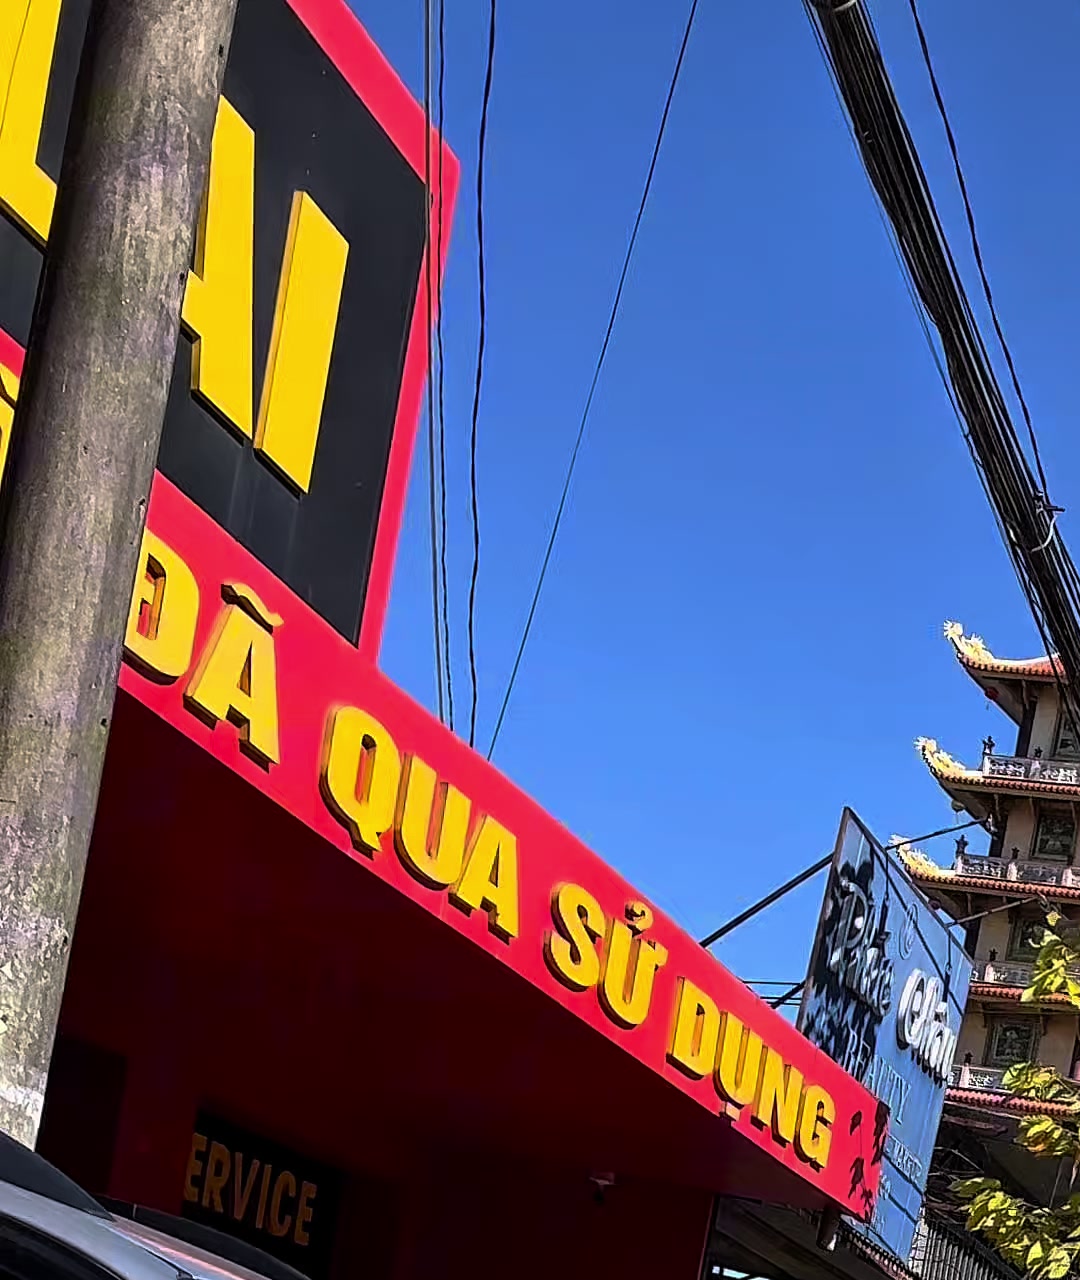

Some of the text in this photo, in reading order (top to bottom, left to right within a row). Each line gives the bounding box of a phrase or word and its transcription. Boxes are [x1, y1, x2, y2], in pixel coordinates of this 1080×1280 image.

[319, 703, 519, 947] QUA
[543, 880, 668, 1031] SỬ
[666, 975, 836, 1173] DỤNG
